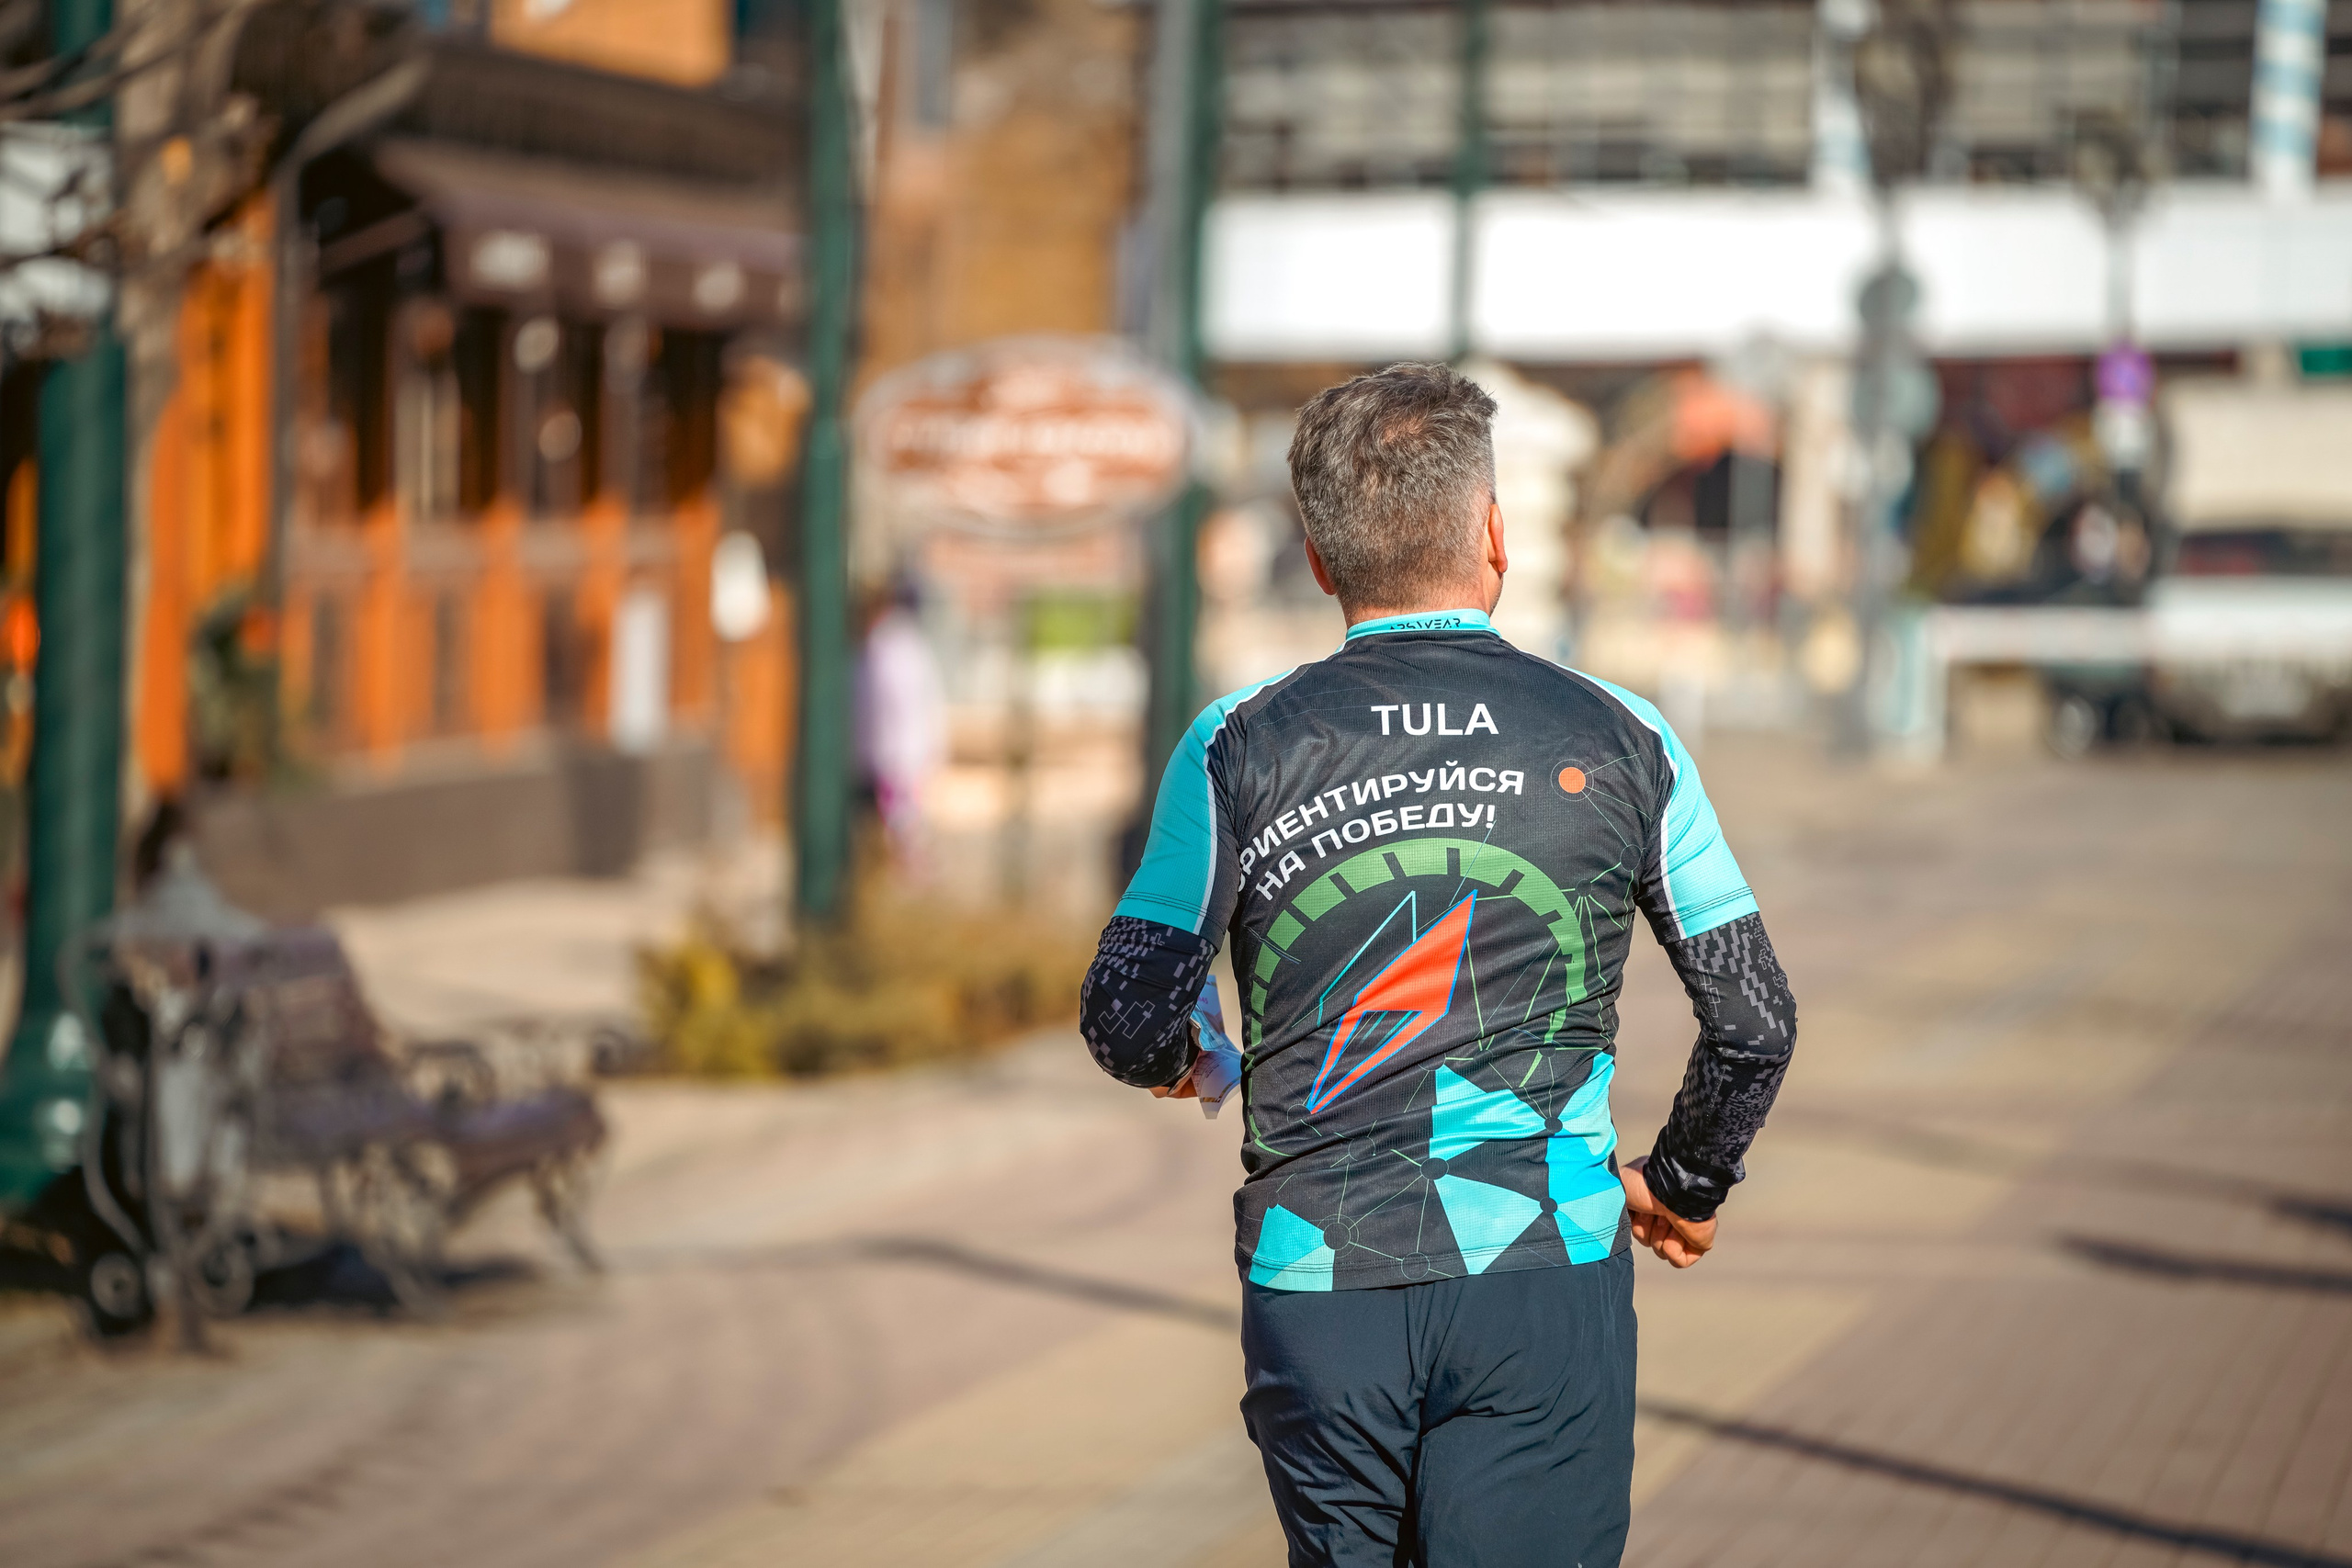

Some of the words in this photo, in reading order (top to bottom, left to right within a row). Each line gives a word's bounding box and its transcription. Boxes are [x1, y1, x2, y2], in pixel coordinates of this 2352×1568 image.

[1371, 703, 1499, 735] TULA
[1255, 850, 1306, 900] НА
[1311, 803, 1495, 859] ПОБЕДУ!
